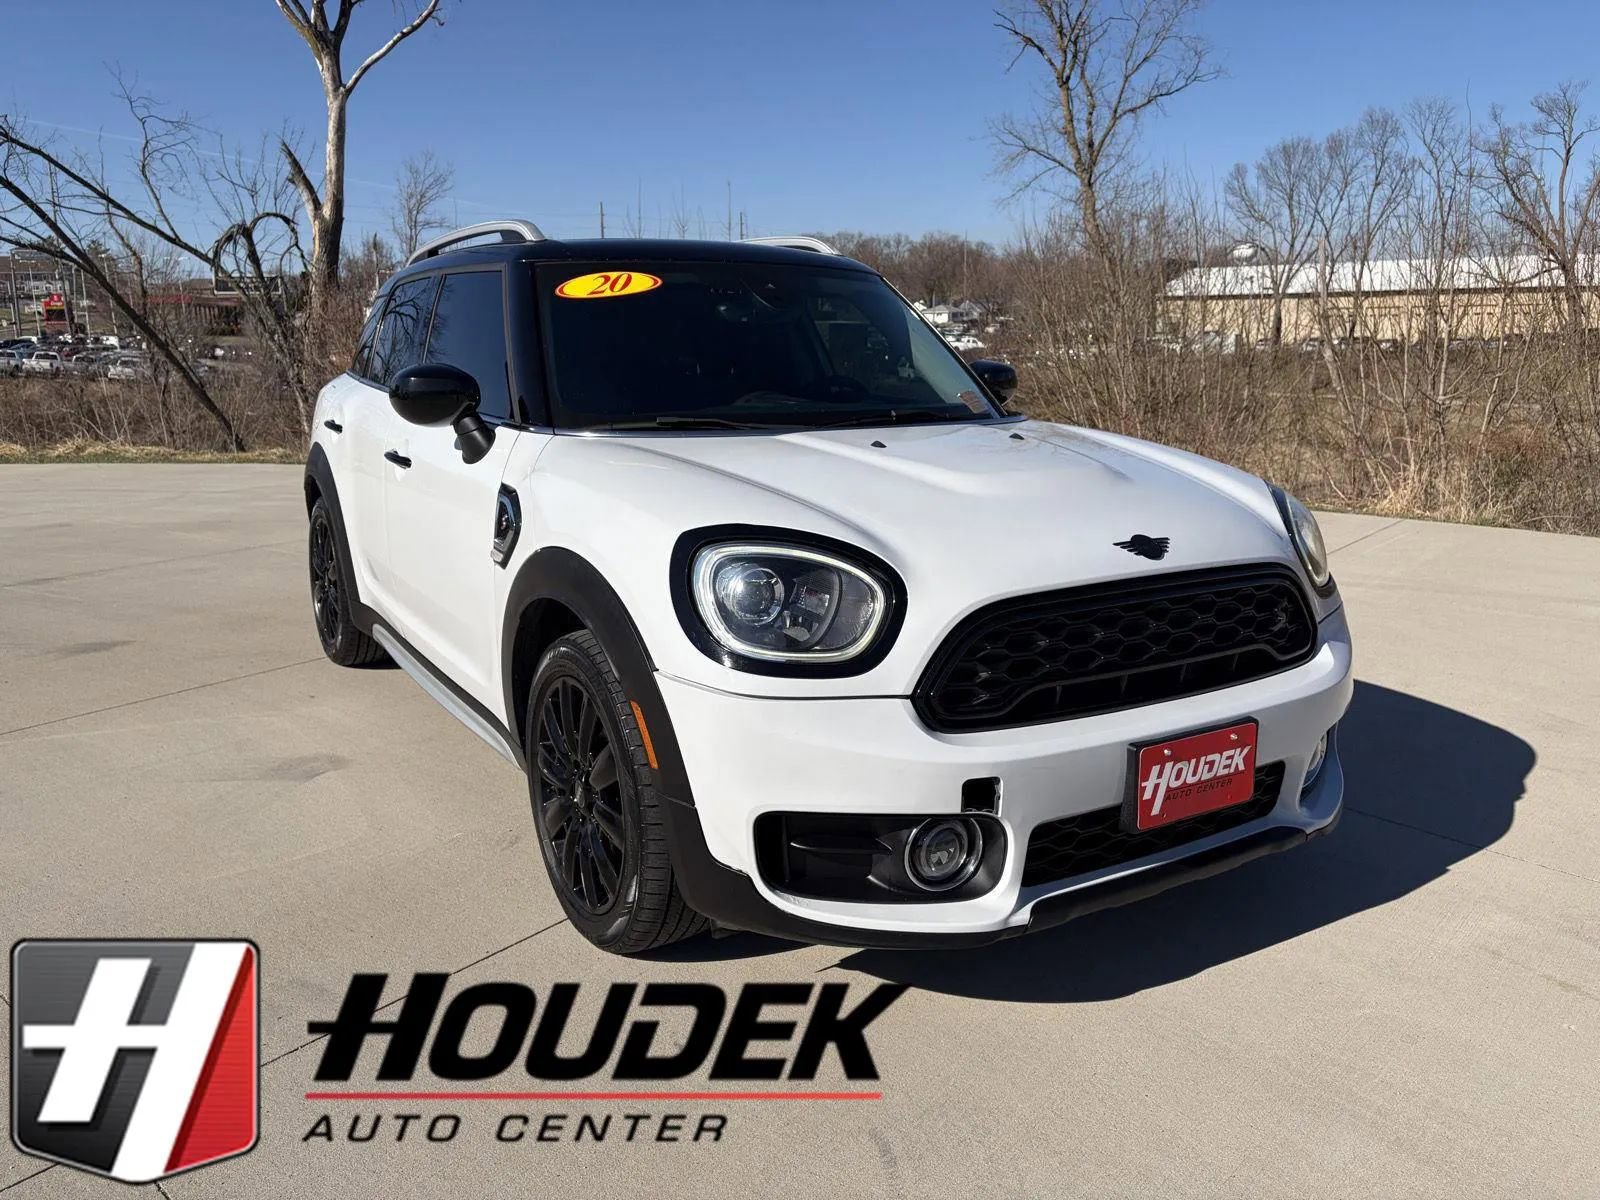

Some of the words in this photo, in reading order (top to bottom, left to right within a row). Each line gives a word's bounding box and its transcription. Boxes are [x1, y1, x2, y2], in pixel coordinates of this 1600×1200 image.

[586, 272, 633, 296] 20
[1141, 745, 1252, 816] HOUDEK
[1164, 790, 1192, 801] AUTO
[1197, 778, 1233, 794] CENTER
